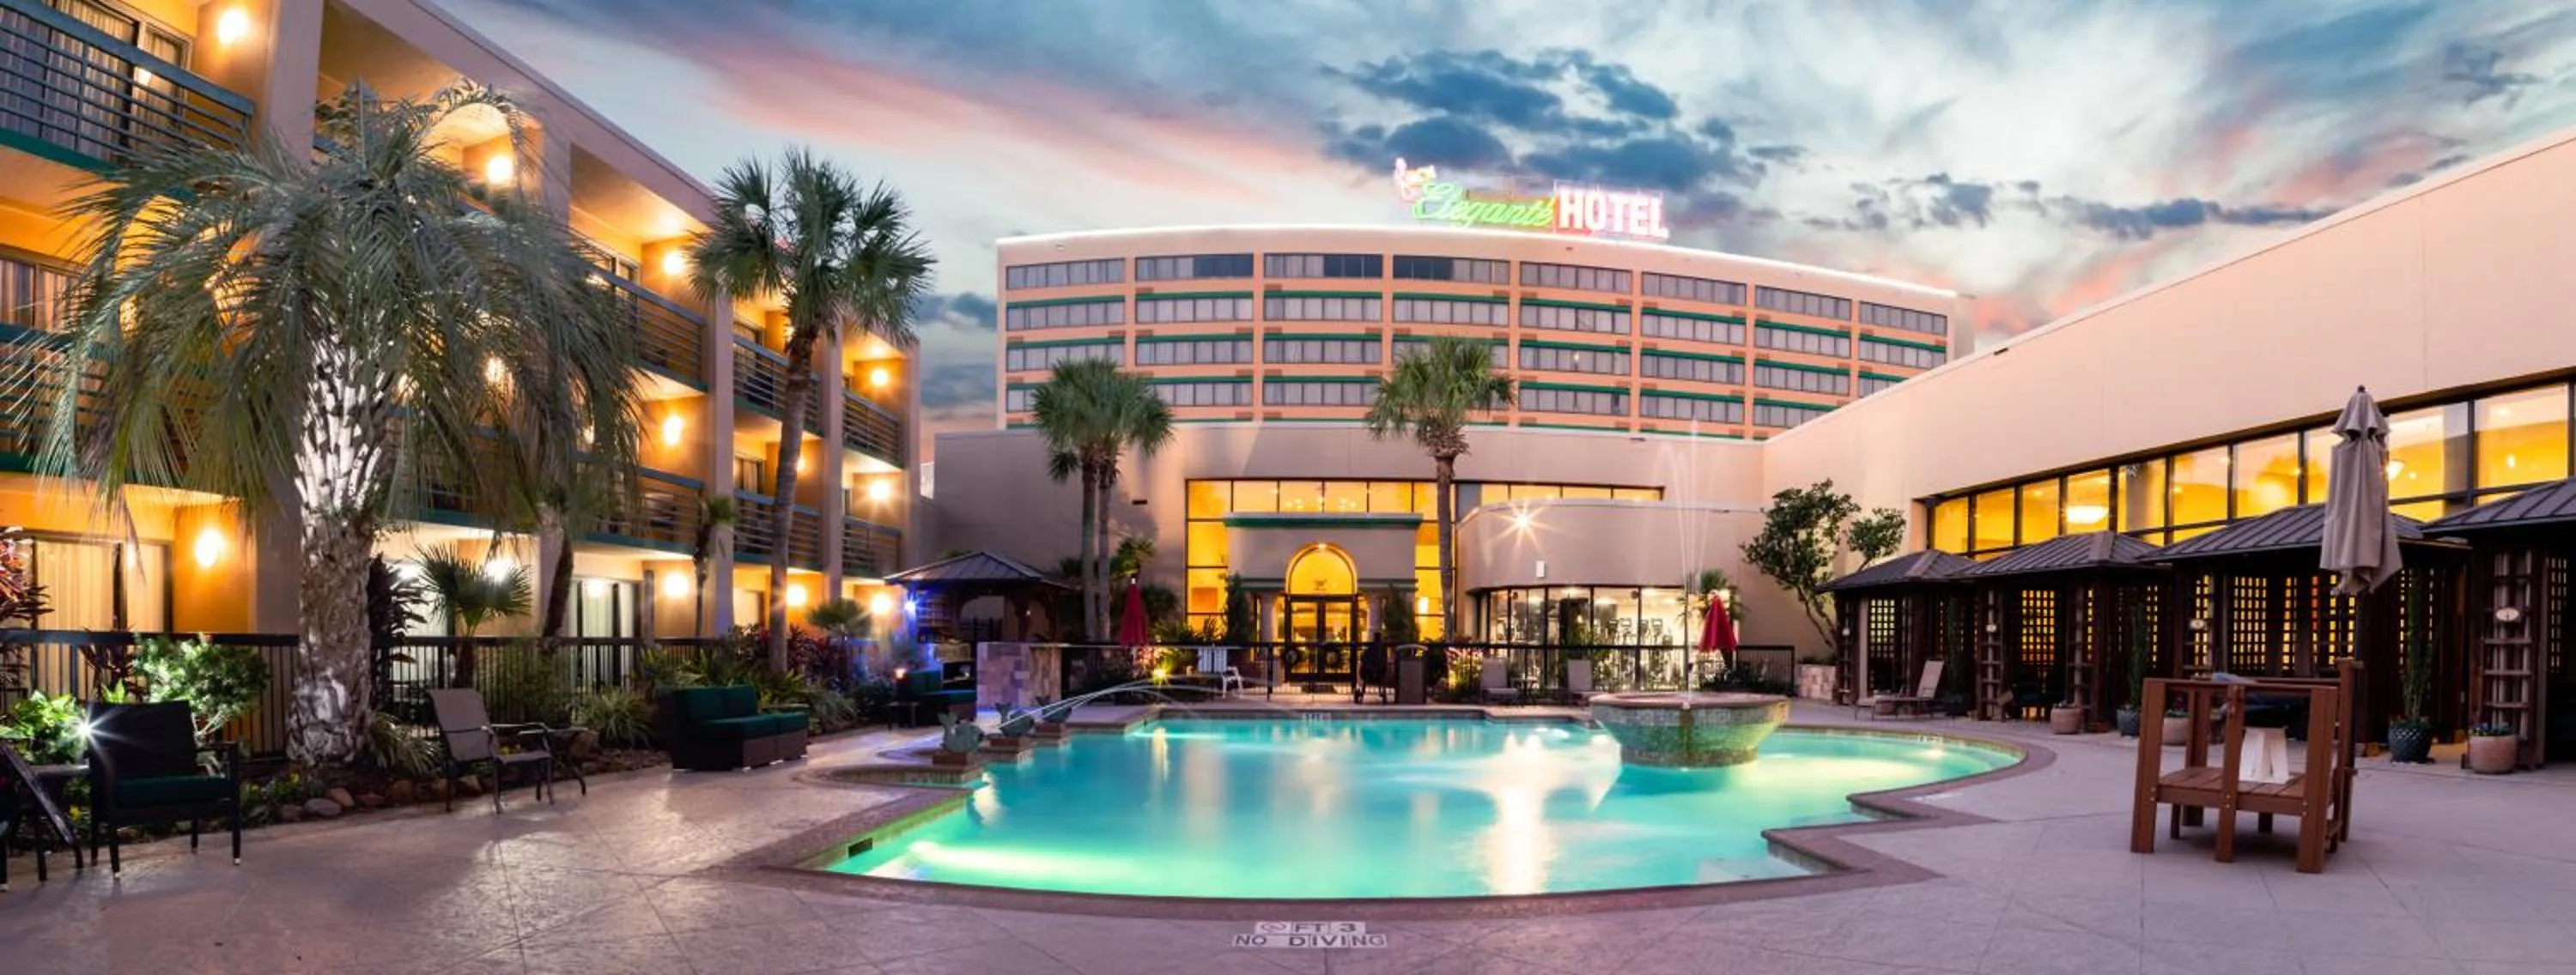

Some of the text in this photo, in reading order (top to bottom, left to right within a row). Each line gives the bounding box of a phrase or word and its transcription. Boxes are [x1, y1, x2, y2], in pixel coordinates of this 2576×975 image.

[1559, 186, 1668, 238] HOTEL
[1295, 923, 1357, 933] FT 3
[1236, 935, 1386, 947] NO DIVING
